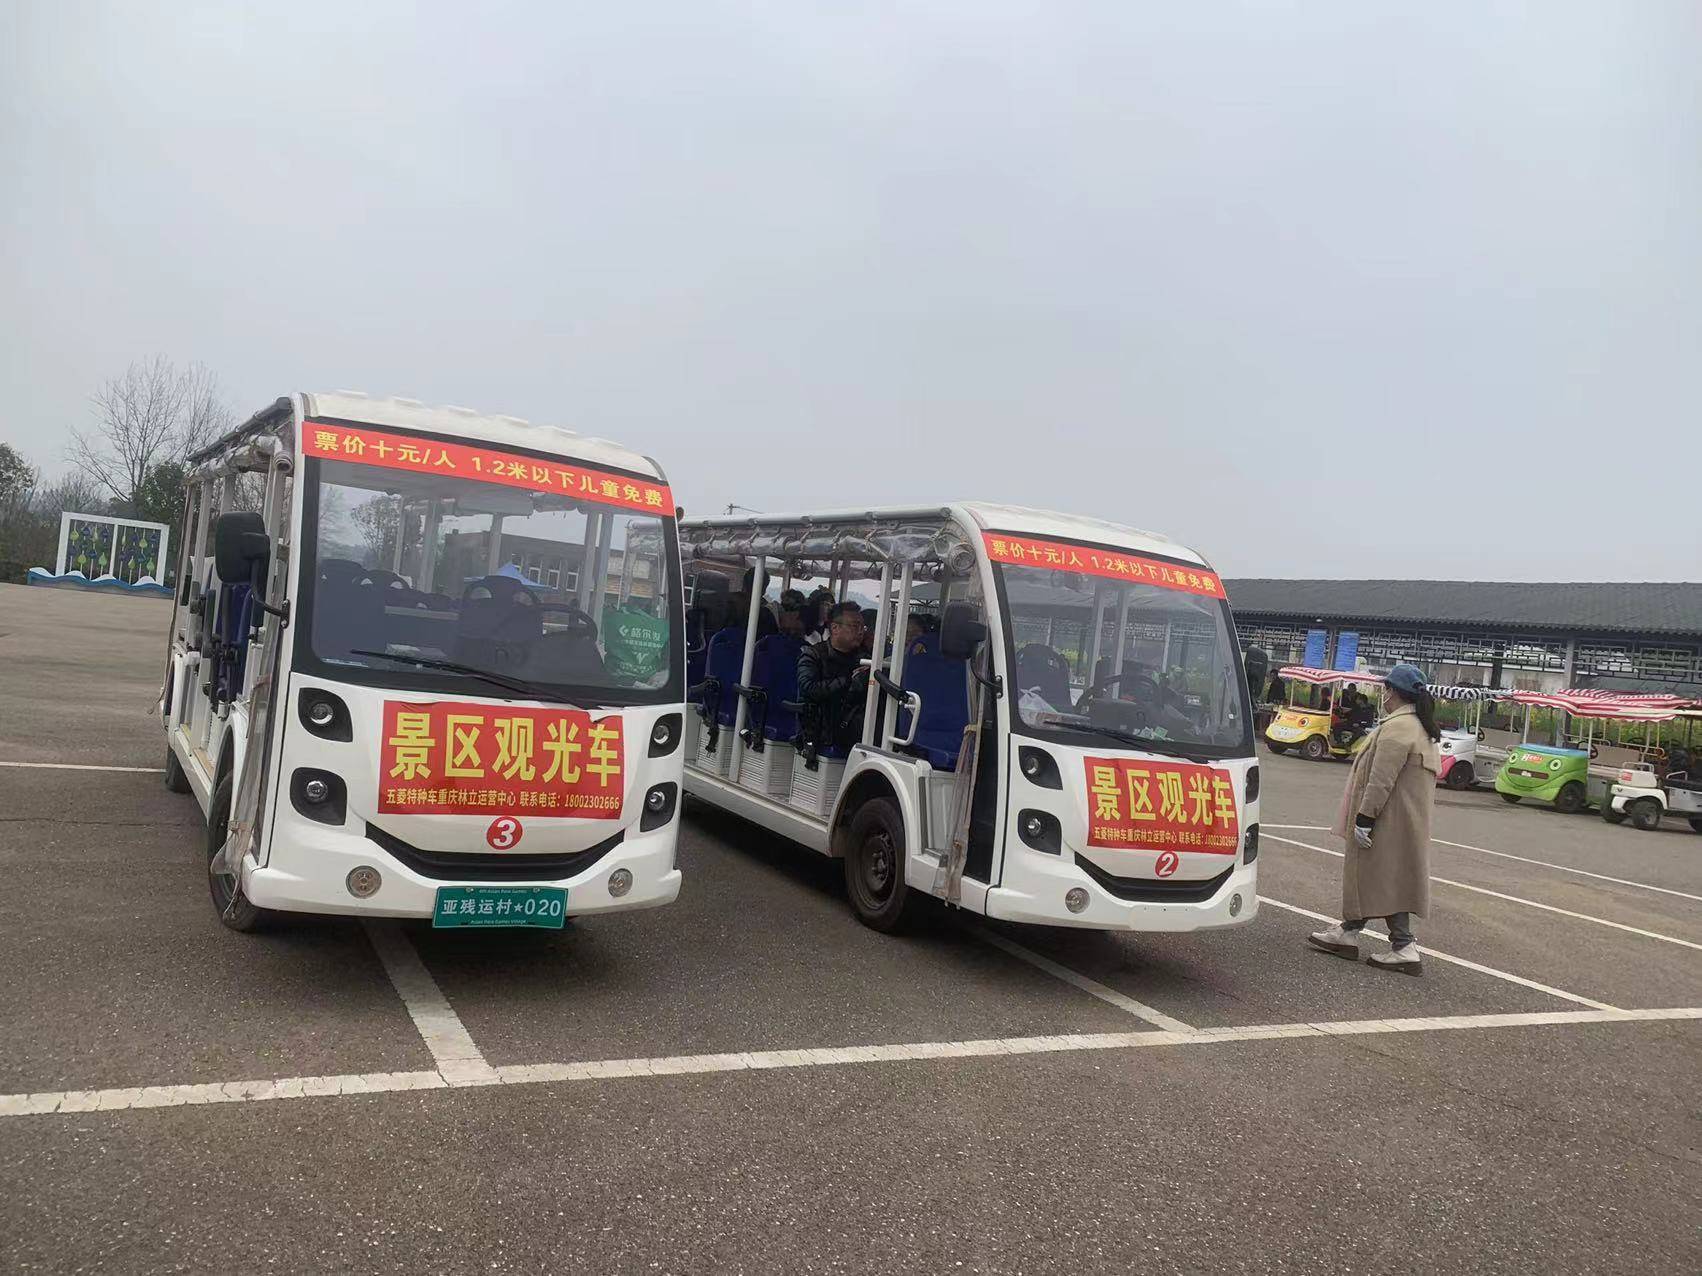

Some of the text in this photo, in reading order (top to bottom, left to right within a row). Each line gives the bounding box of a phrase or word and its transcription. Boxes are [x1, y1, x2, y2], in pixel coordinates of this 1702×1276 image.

[314, 431, 663, 507] 票价十元/人 1.2米以下儿童免费
[991, 540, 1216, 591] 票价十元/人 1.2米以下儿童免费
[388, 712, 622, 787] 景区观光车
[386, 788, 516, 807] 五菱特种车重庆林立运营中心
[1091, 766, 1235, 828] 景区观光车
[493, 819, 516, 847] 3
[1159, 853, 1175, 876] 2
